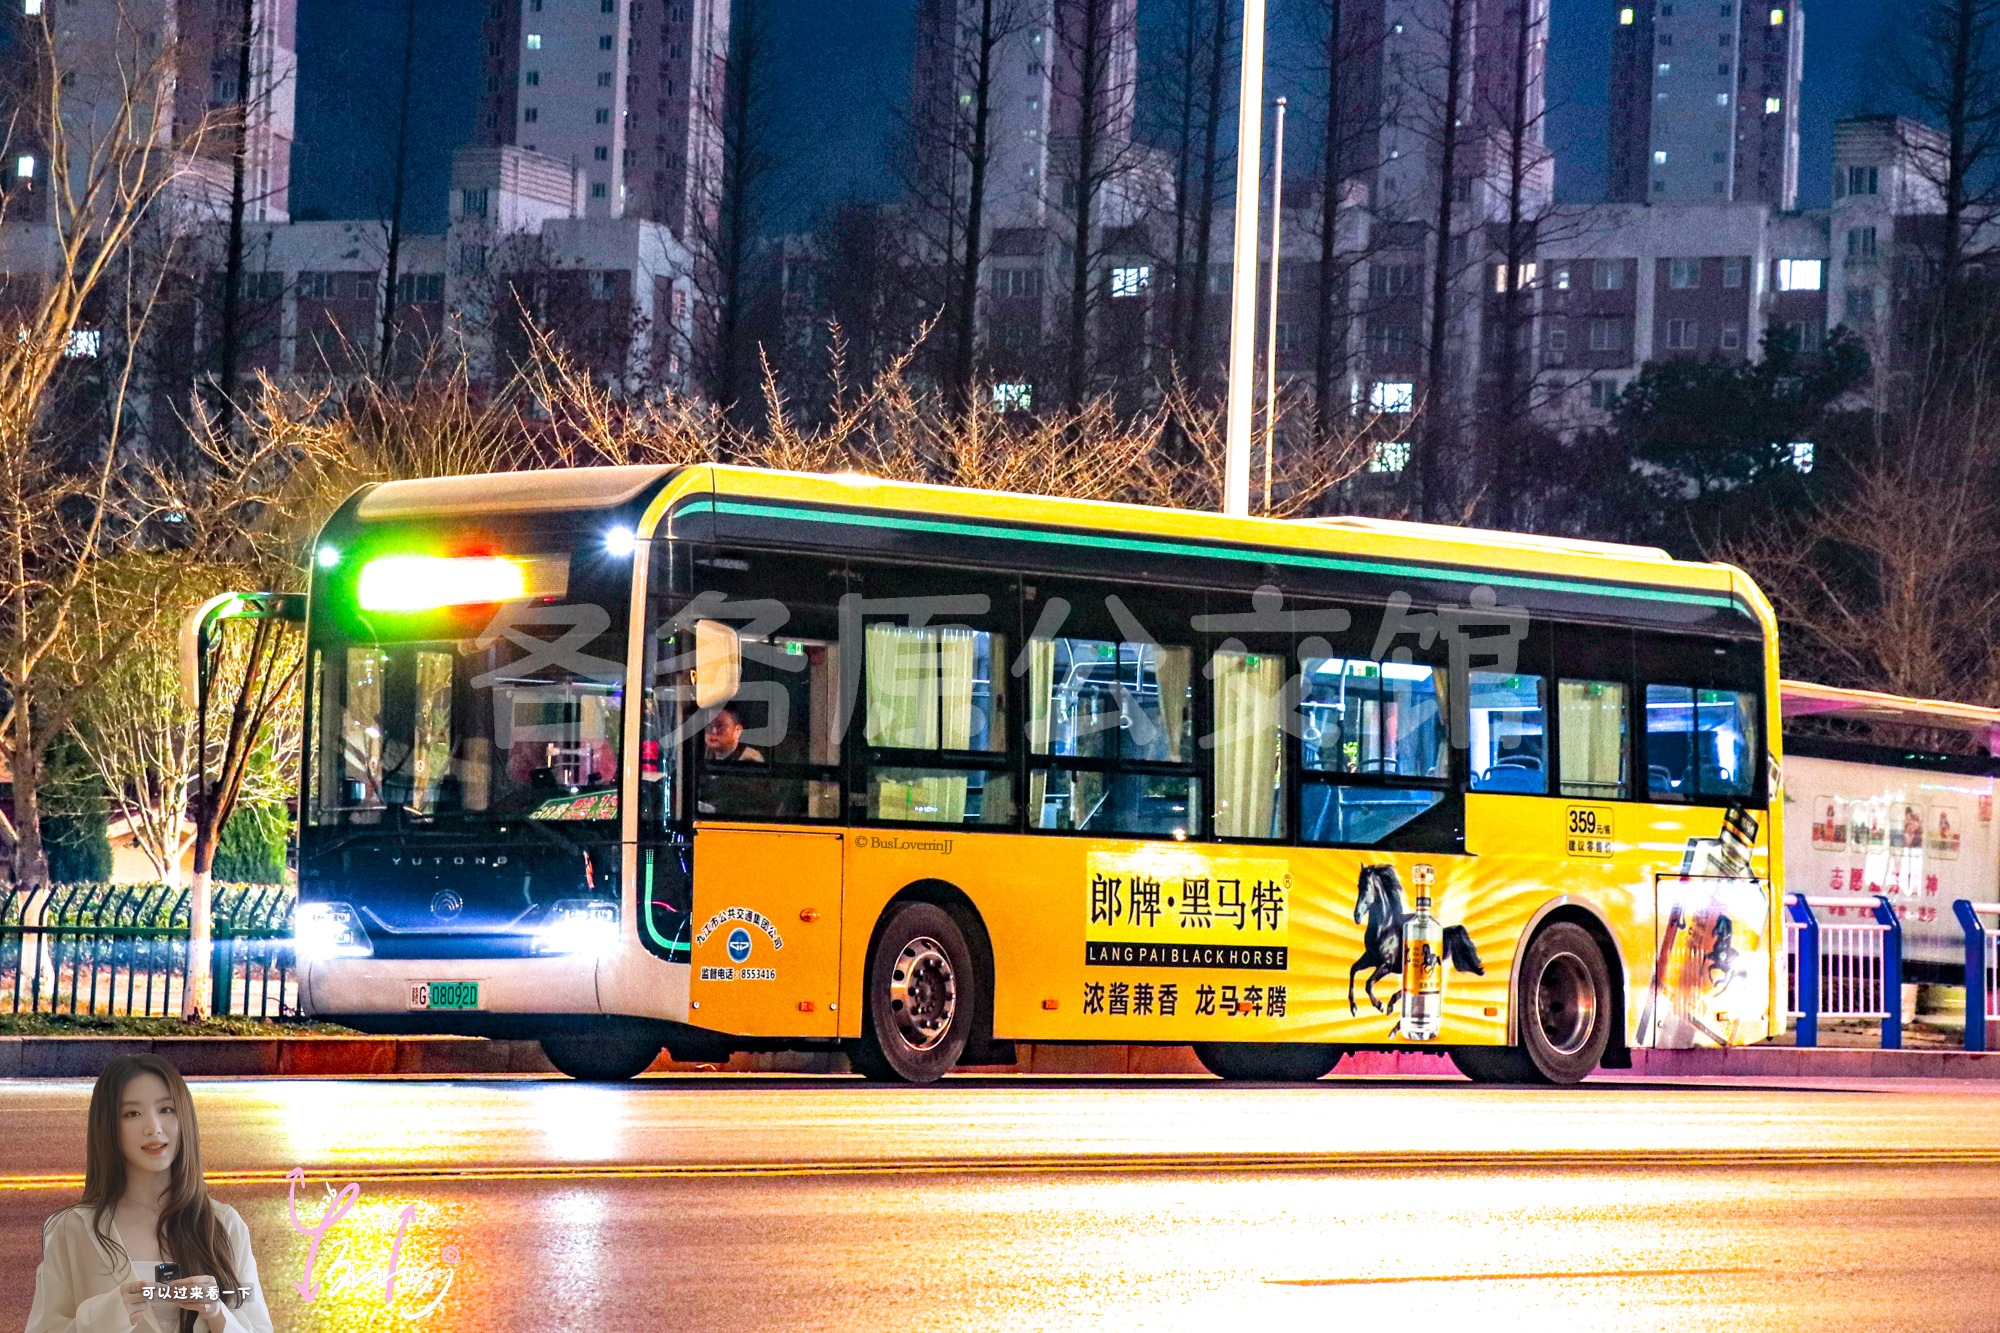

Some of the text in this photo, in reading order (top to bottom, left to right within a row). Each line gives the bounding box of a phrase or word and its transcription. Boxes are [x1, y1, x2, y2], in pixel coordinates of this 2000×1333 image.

[392, 856, 508, 866] YUTONG
[1089, 947, 1133, 961] LANG
[1230, 951, 1284, 965] HORSE
[1083, 982, 1287, 1018] 浓酱兼香 龙马奔腾
